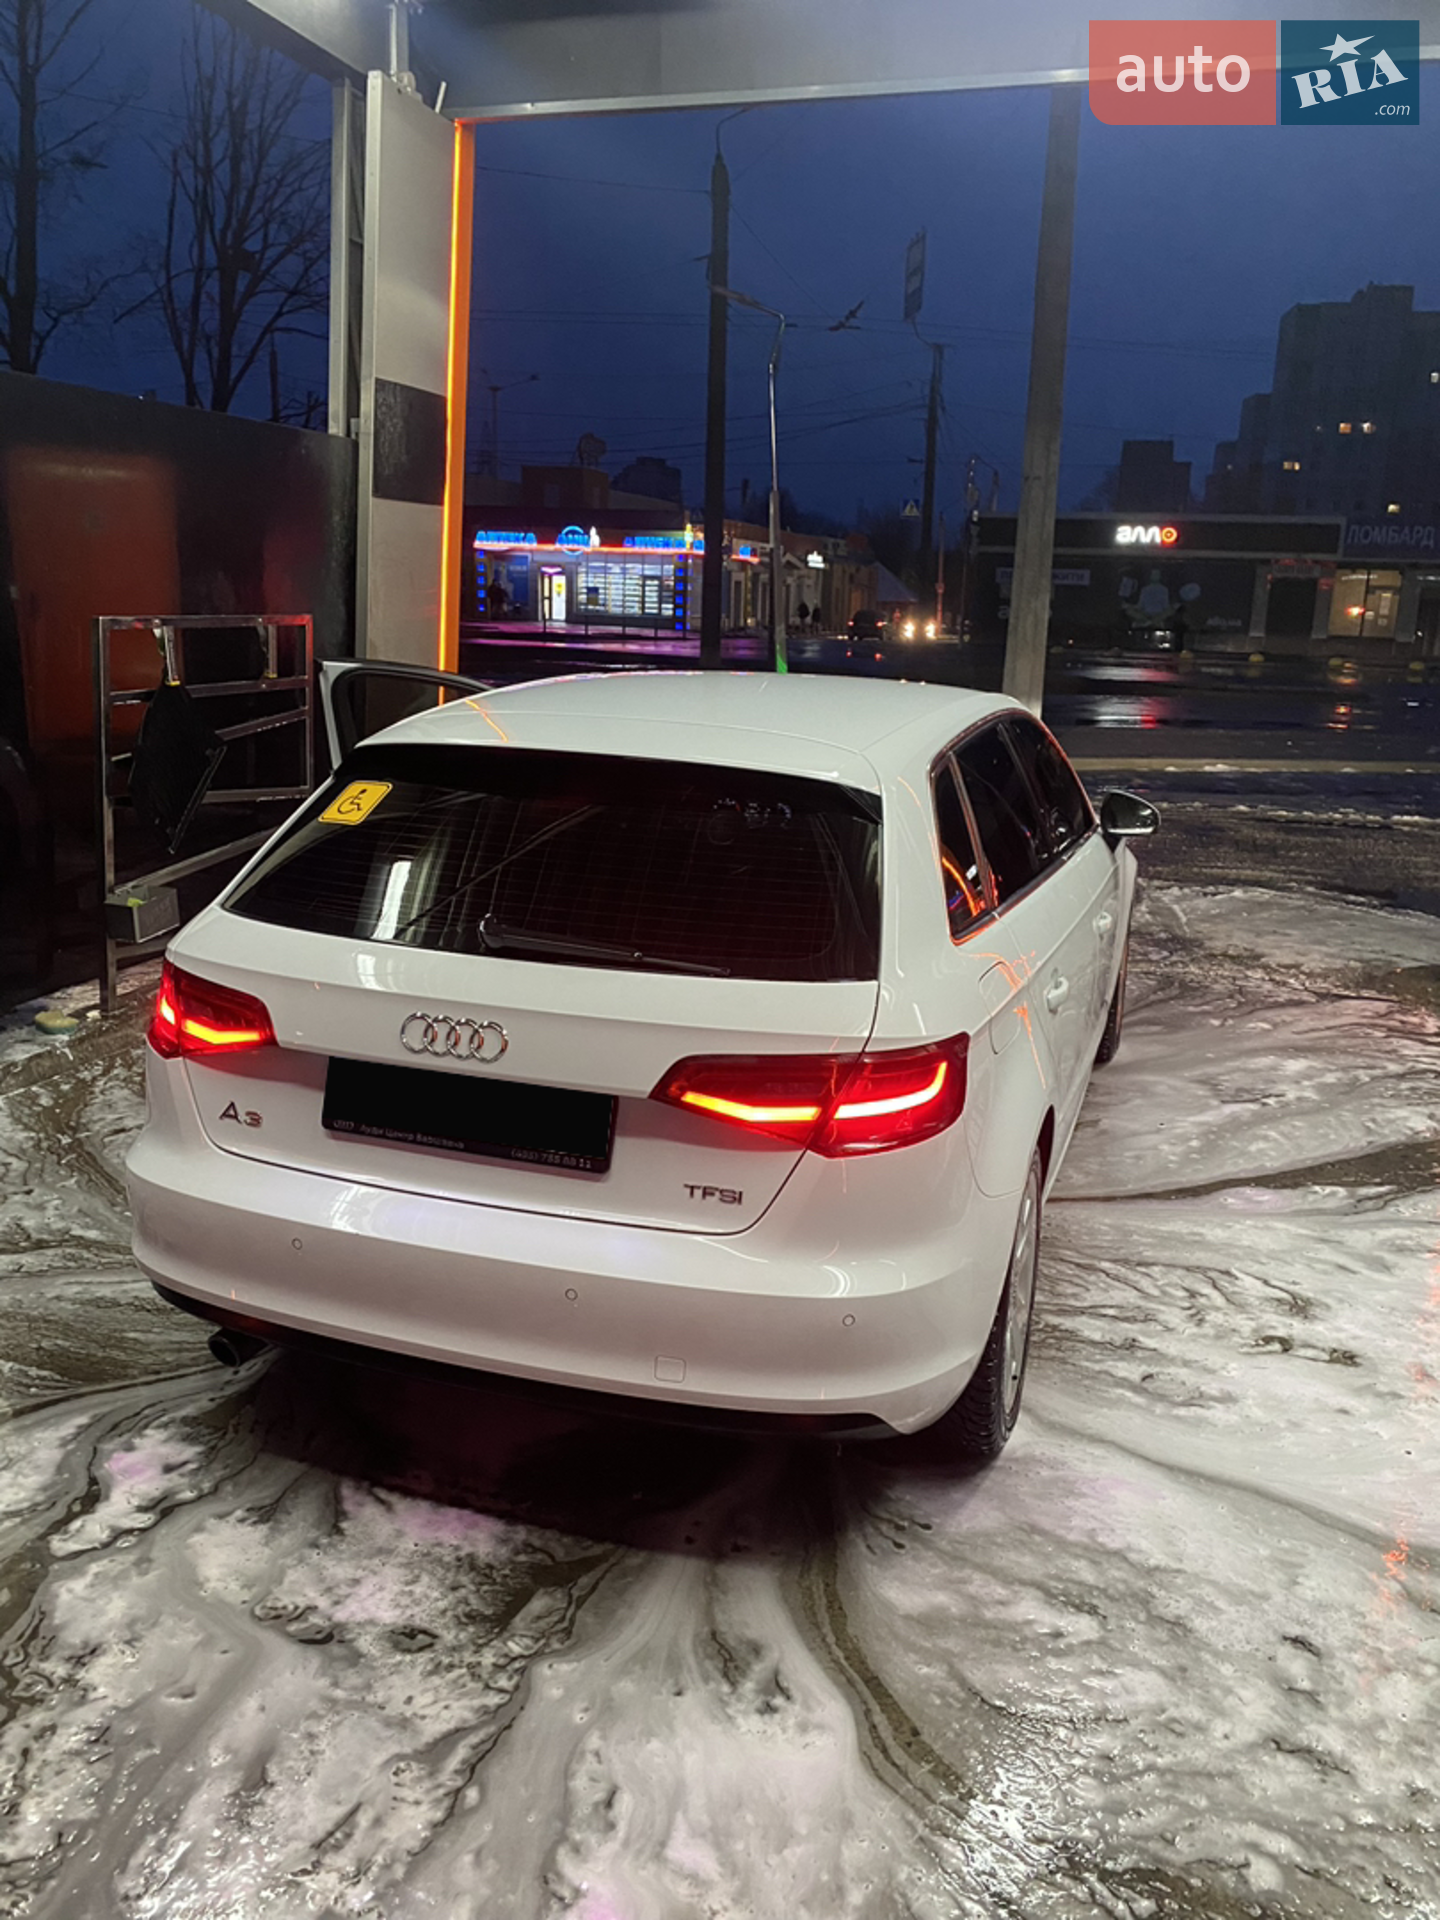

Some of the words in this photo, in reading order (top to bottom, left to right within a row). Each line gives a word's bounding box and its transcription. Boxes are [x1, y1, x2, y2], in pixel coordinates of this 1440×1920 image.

[1115, 524, 1178, 543] алло
[1346, 524, 1436, 549] ЛОМБАРД
[218, 1100, 263, 1129] A3
[683, 1183, 743, 1206] TFSI
